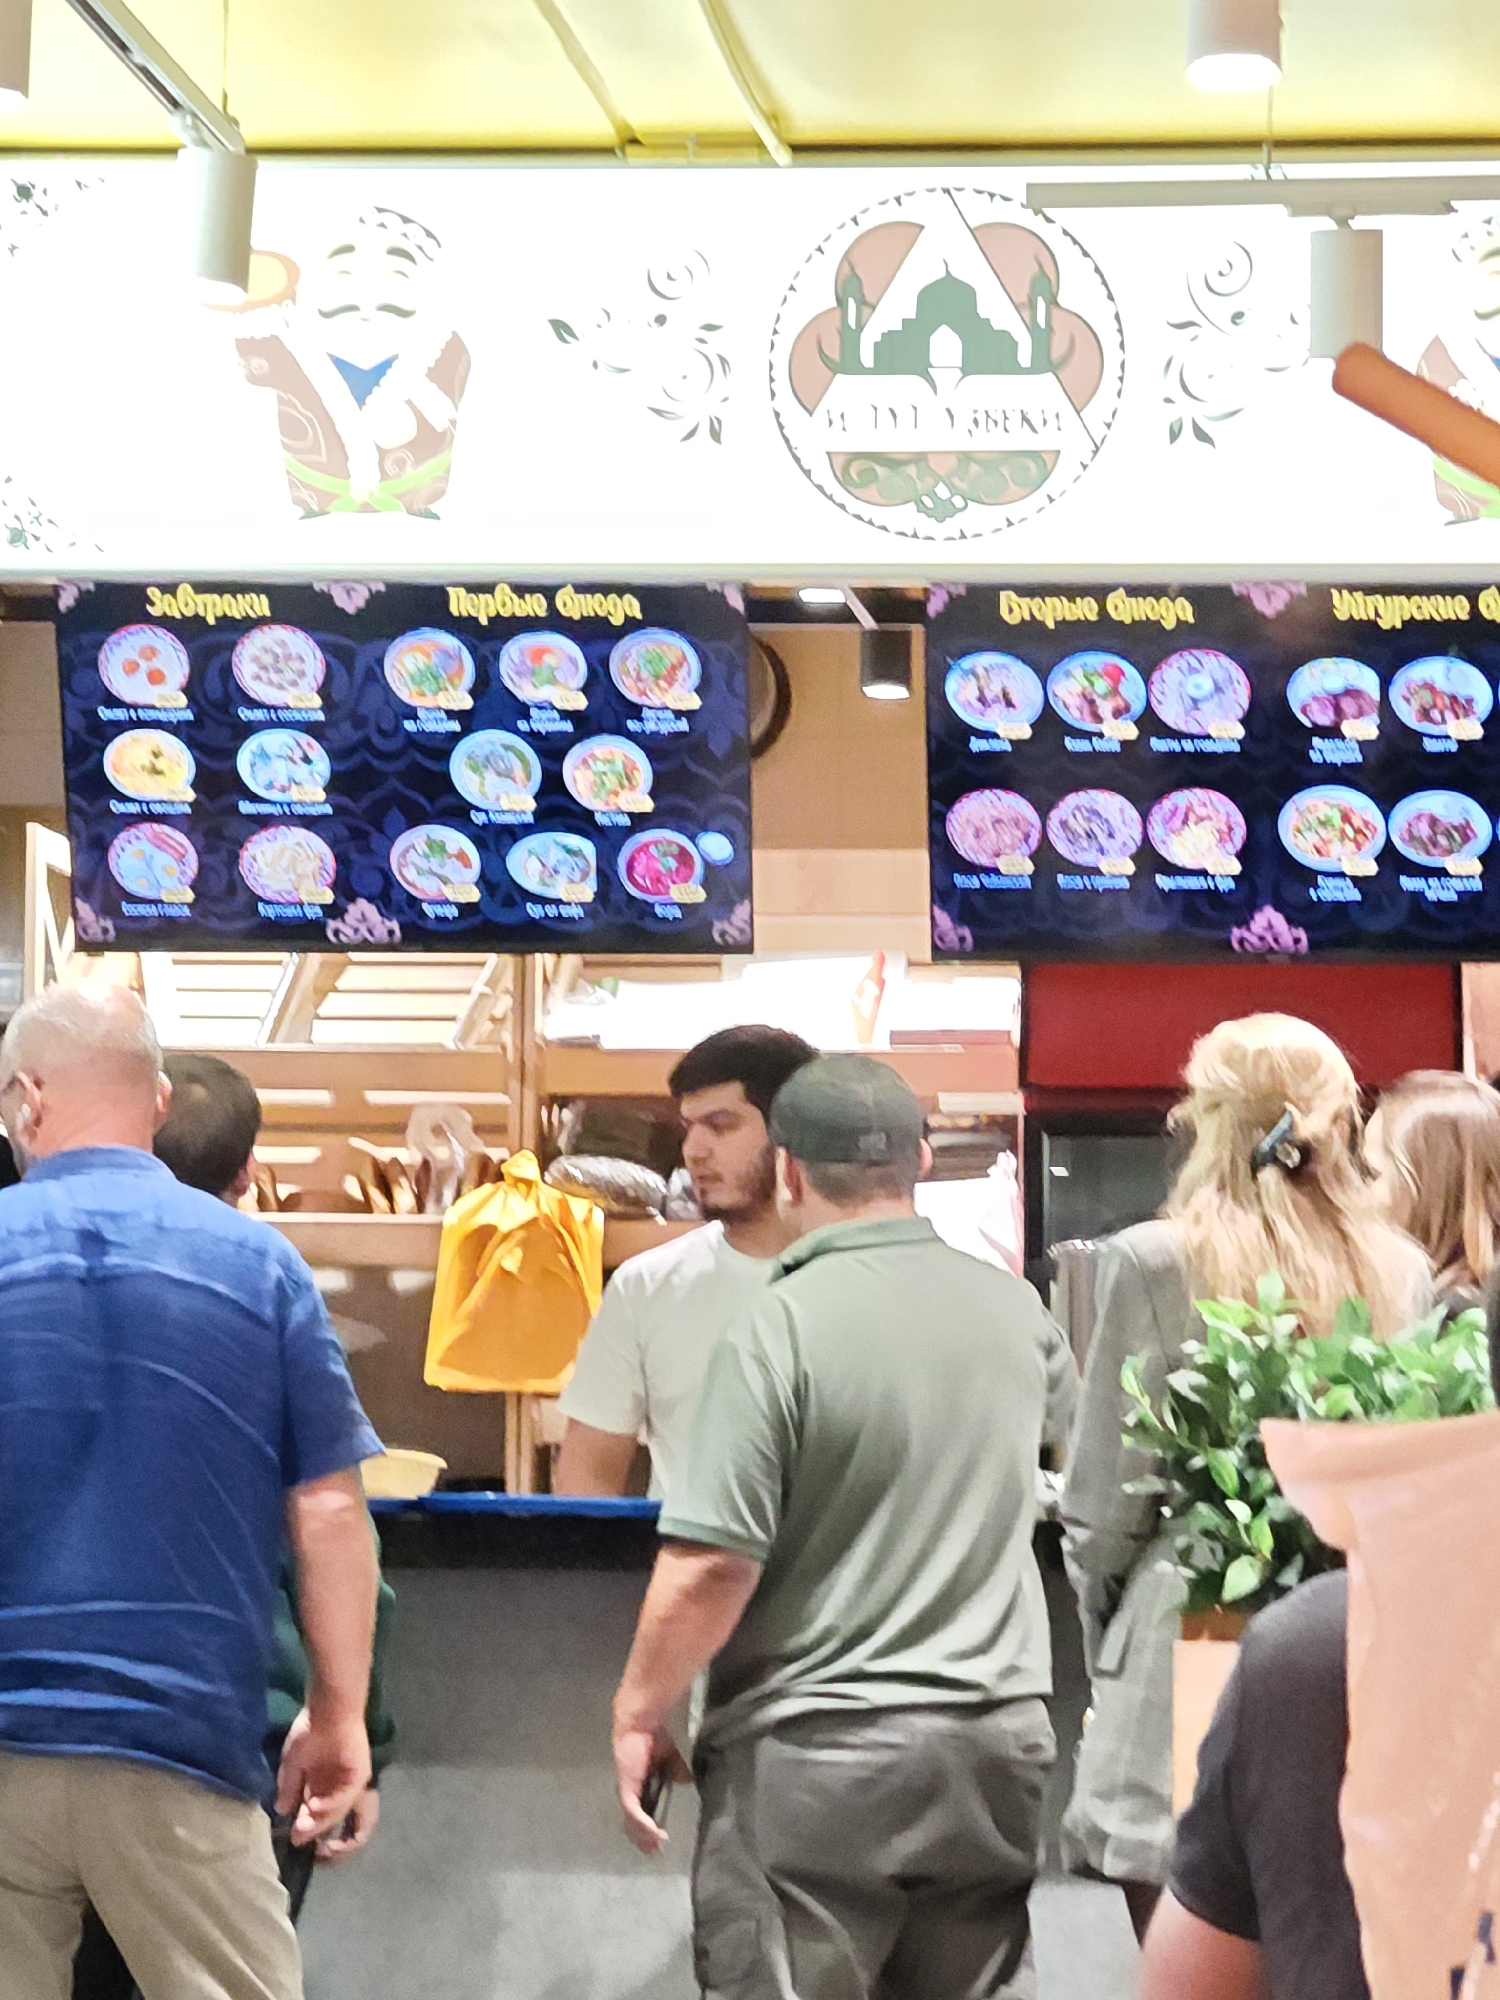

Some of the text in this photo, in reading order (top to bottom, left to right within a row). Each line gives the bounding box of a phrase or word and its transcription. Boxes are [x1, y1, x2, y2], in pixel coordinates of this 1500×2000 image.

[146, 583, 271, 625] Завтраки
[446, 583, 643, 626] Первые блюда
[999, 587, 1195, 630] Вторые блюда
[1330, 588, 1470, 630] Уйгурские
